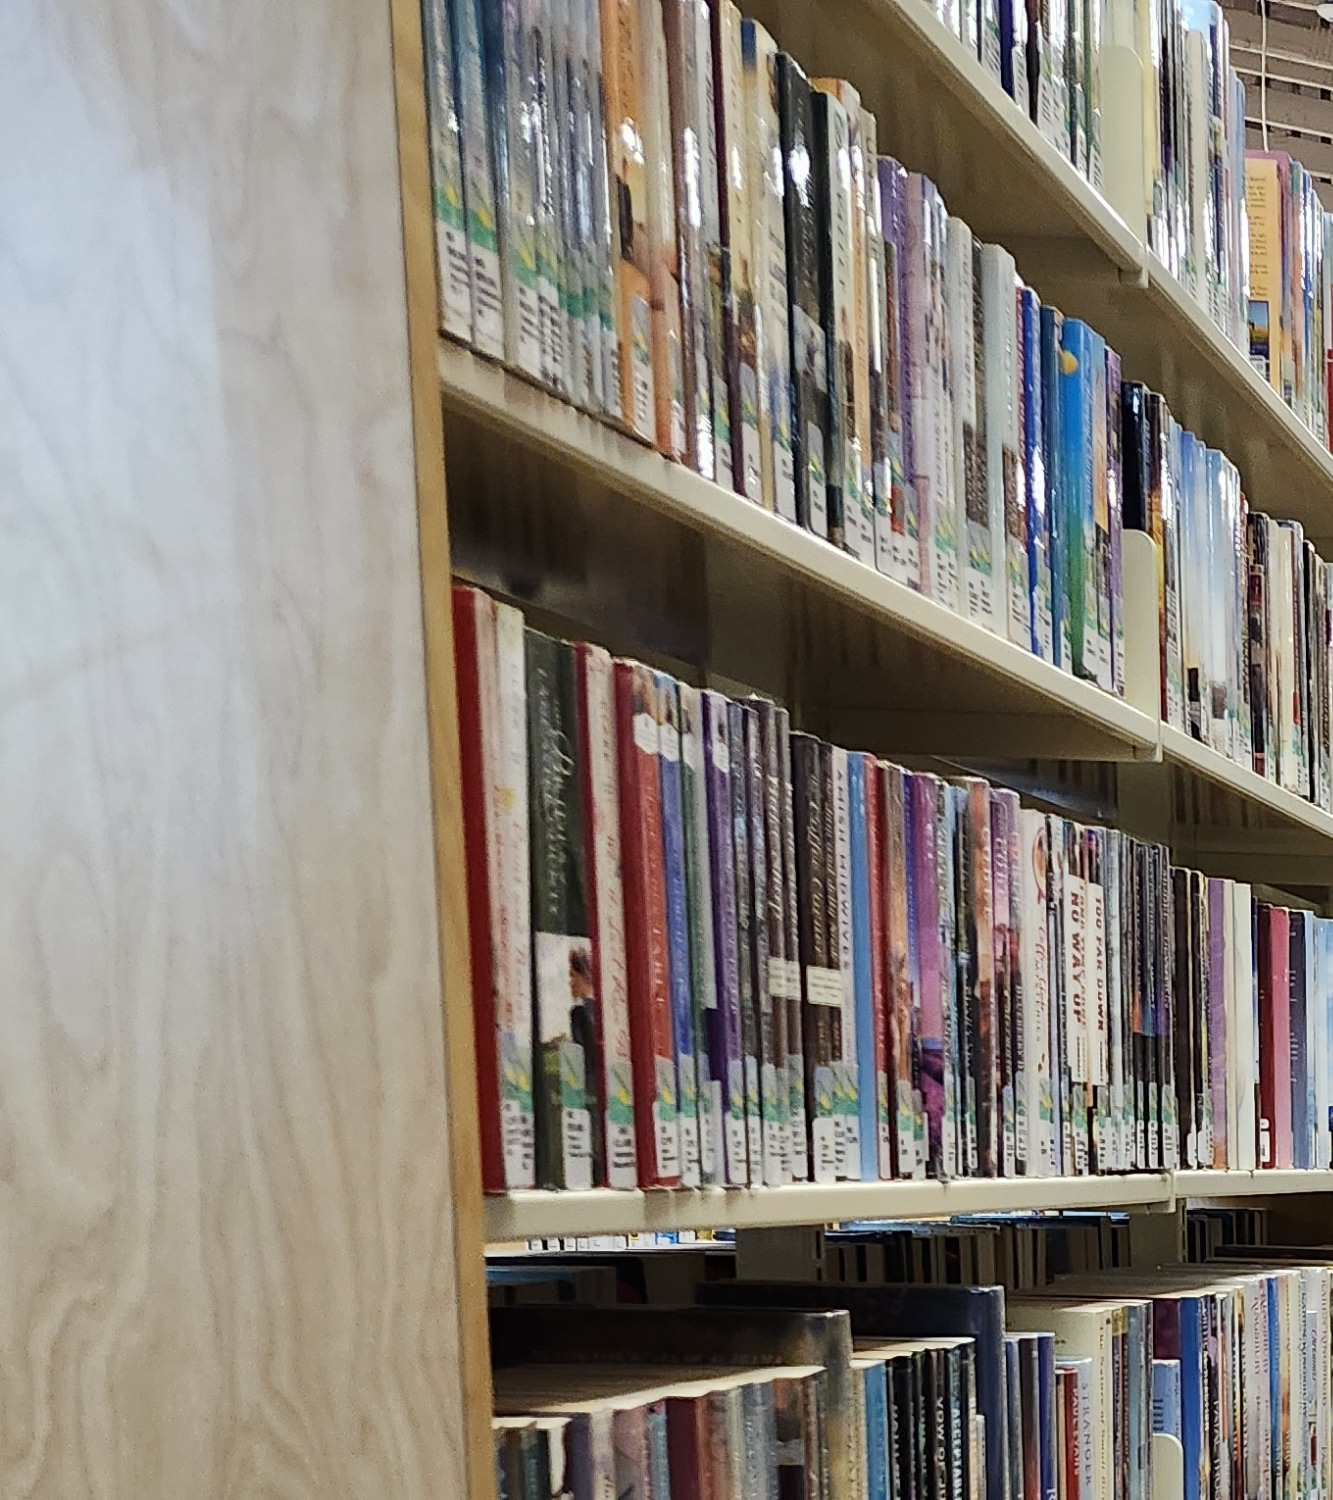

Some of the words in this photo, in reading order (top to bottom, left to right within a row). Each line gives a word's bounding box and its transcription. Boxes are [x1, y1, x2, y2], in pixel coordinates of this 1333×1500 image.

[836, 768, 848, 843] AMISH
[839, 853, 851, 970] MIDWIVES
[1070, 891, 1081, 923] NO
[1094, 897, 1102, 929] TOO
[1071, 931, 1083, 983] WAY
[1095, 938, 1103, 973] FAR
[1071, 992, 1083, 1025] UP
[1096, 978, 1105, 1031] DOWN
[1098, 1356, 1106, 1404] Nature
